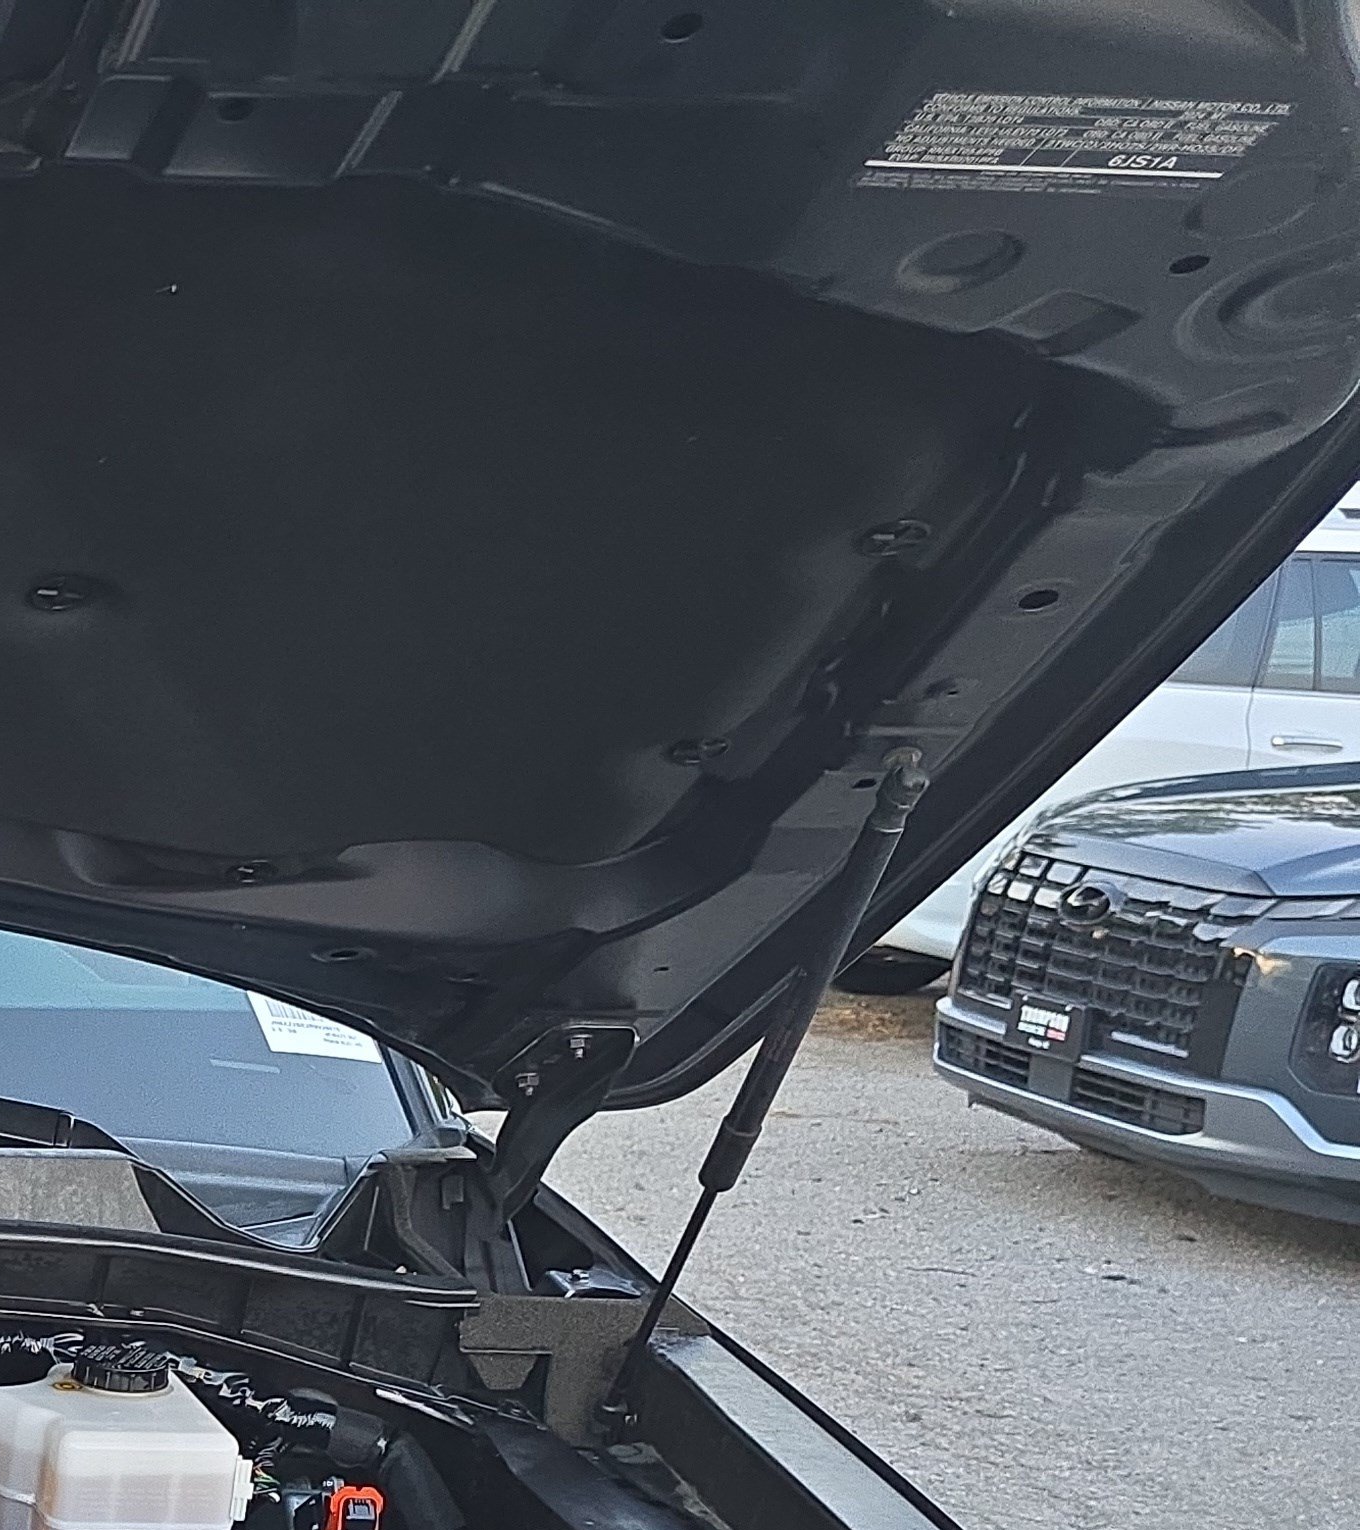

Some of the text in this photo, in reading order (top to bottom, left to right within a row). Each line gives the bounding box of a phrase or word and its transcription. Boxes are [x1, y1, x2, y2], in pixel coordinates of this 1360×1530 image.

[989, 105, 1004, 113] TO
[1150, 100, 1196, 110] NISSAN
[1108, 155, 1178, 169] 6JS1A
